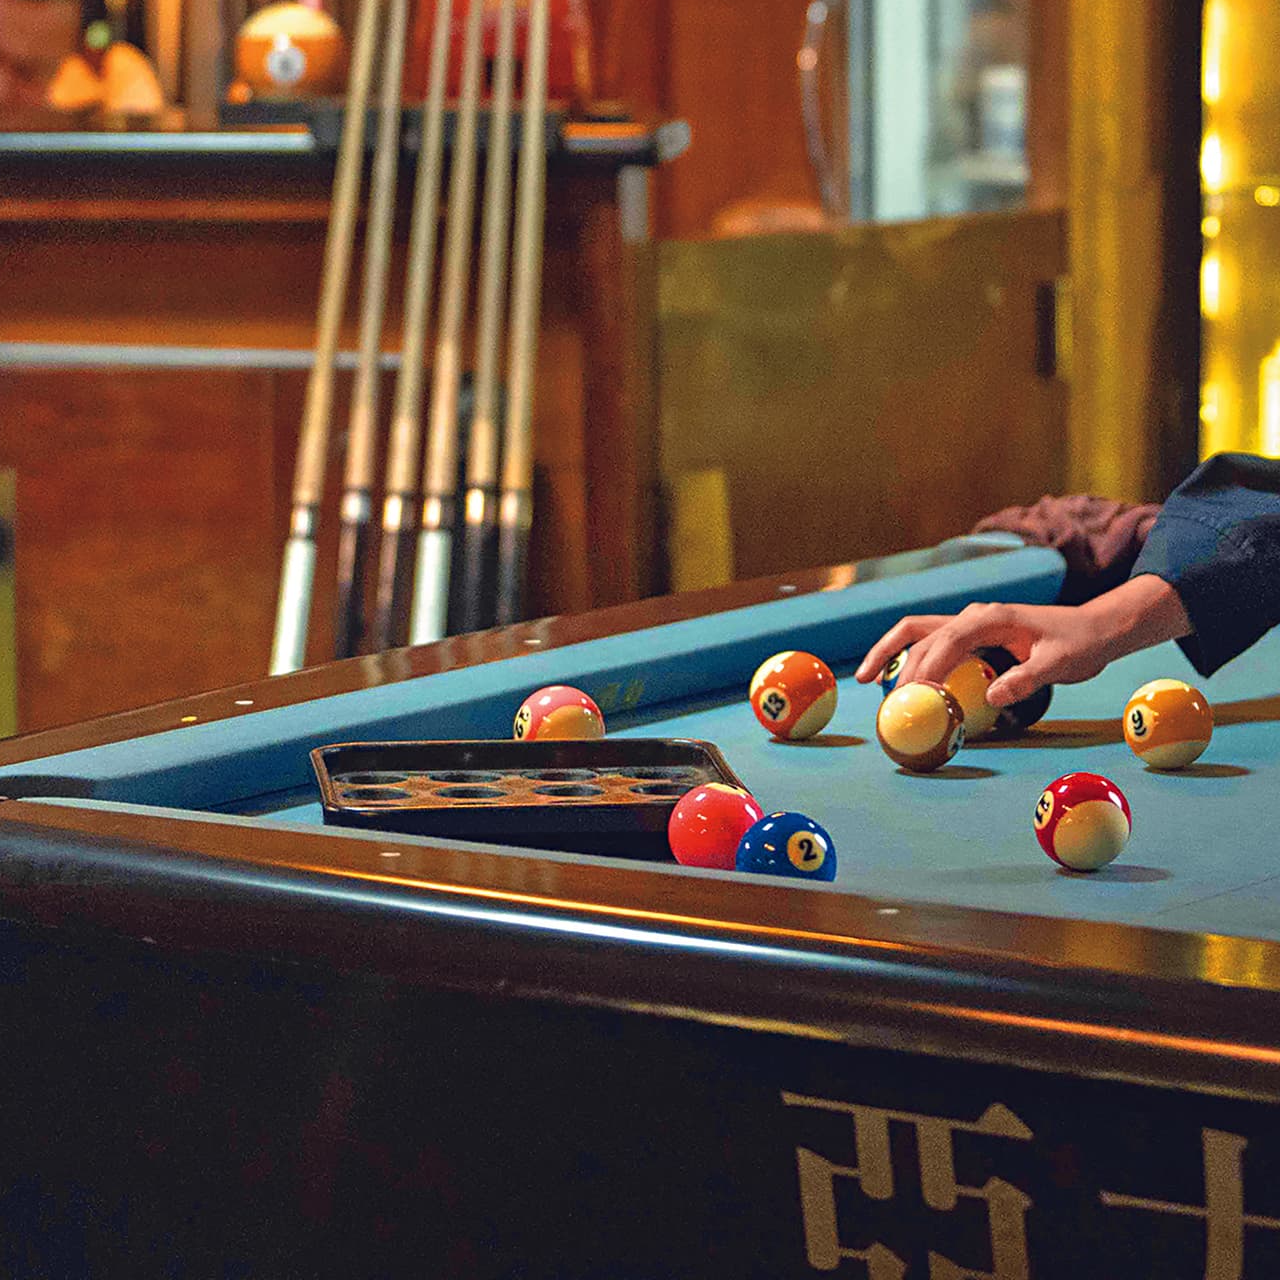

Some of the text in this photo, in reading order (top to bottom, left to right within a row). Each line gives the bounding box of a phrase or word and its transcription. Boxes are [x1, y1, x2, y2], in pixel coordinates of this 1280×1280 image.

[762, 691, 787, 720] 13
[1131, 709, 1145, 734] 9
[799, 838, 817, 862] 2
